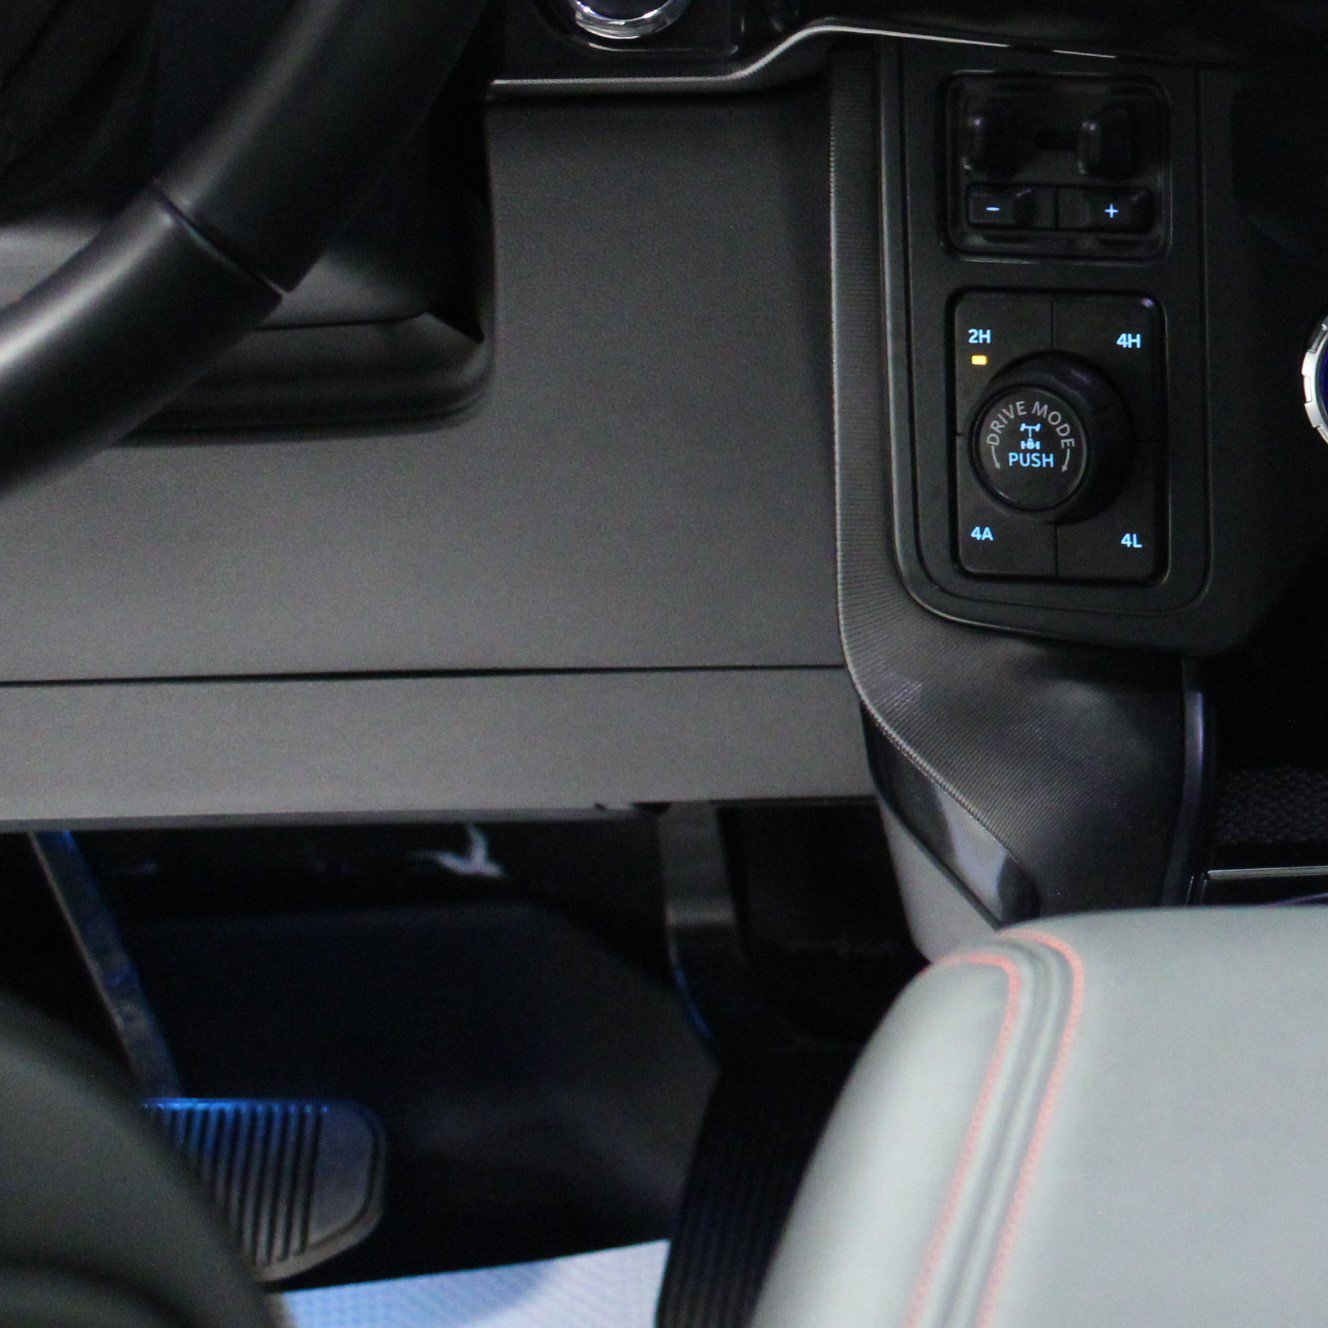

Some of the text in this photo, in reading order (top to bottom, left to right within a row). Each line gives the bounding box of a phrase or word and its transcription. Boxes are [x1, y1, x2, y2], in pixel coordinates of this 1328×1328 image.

[968, 329, 991, 343] 2H
[1116, 333, 1141, 348] 4H
[985, 401, 1075, 449] DRIVE MODE
[1009, 453, 1054, 467] PUSH
[971, 526, 993, 541] 4A
[1121, 534, 1142, 548] 4L
